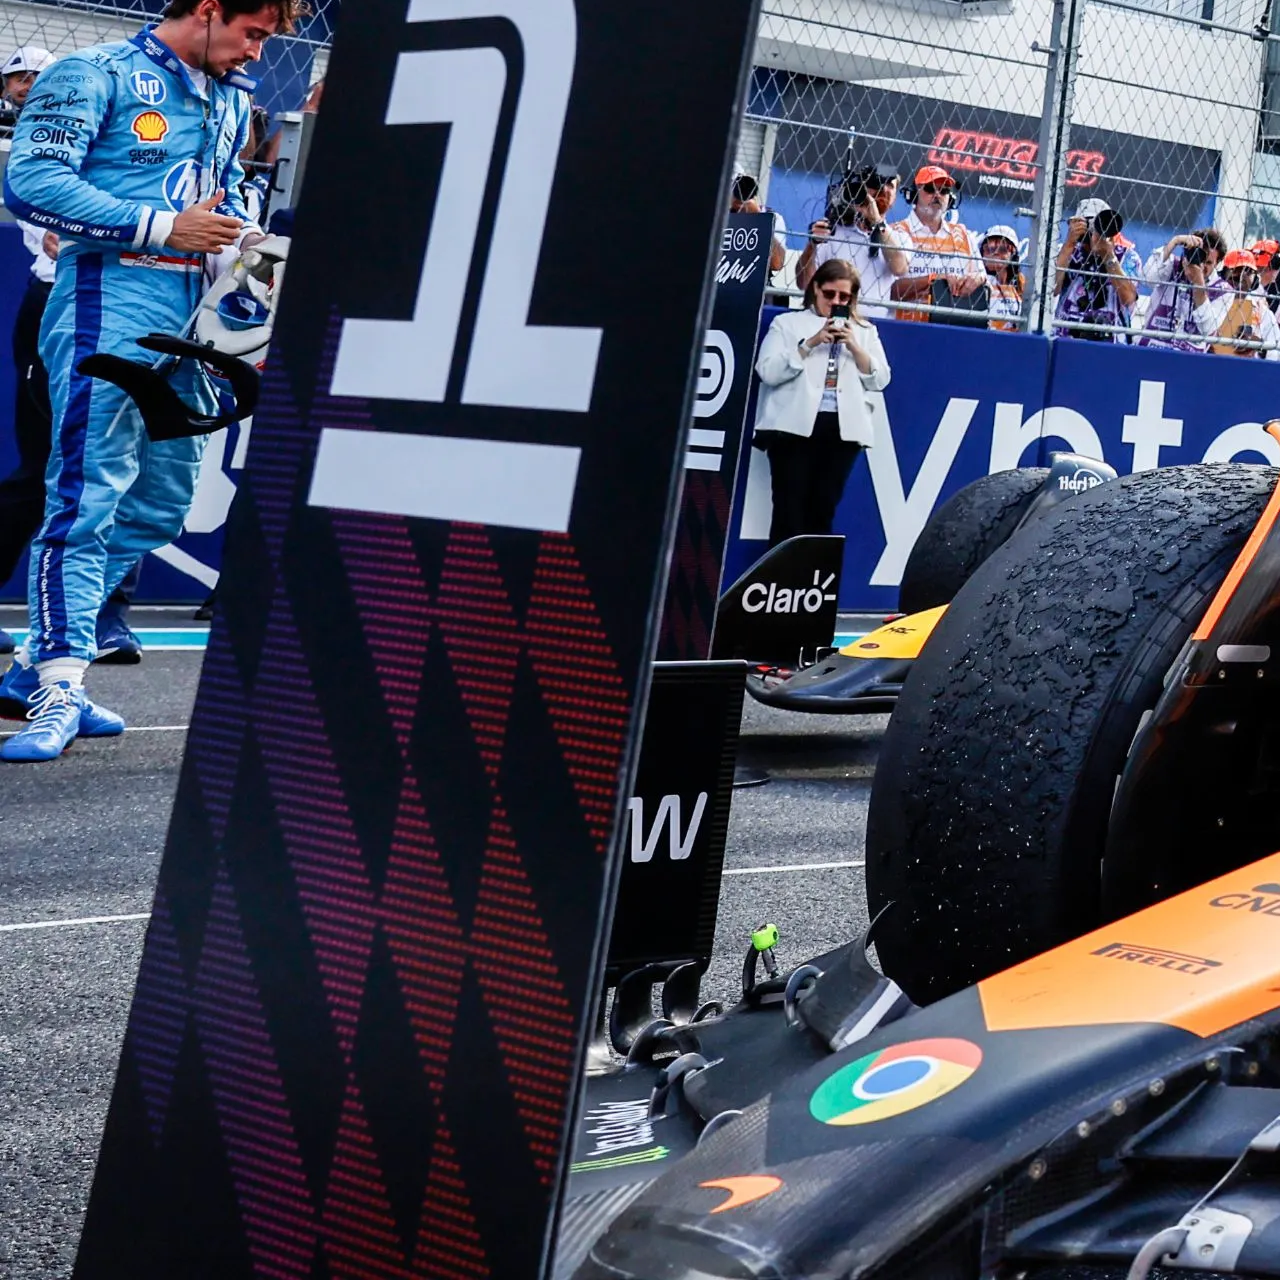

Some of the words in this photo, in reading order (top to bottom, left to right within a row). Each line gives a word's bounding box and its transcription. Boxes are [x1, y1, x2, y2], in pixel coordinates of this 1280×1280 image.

[50, 74, 94, 85] GENESYS
[135, 71, 160, 105] hp
[129, 148, 169, 157] GLOBAL
[131, 156, 165, 165] POKER
[928, 129, 1105, 187] KNUCES
[980, 175, 1000, 186] NOW
[1001, 177, 1035, 192] STREAM
[30, 211, 84, 235] RICHARD
[89, 224, 121, 238] MILLE
[742, 580, 824, 613] Claro
[1089, 942, 1223, 975] PIRELLI
